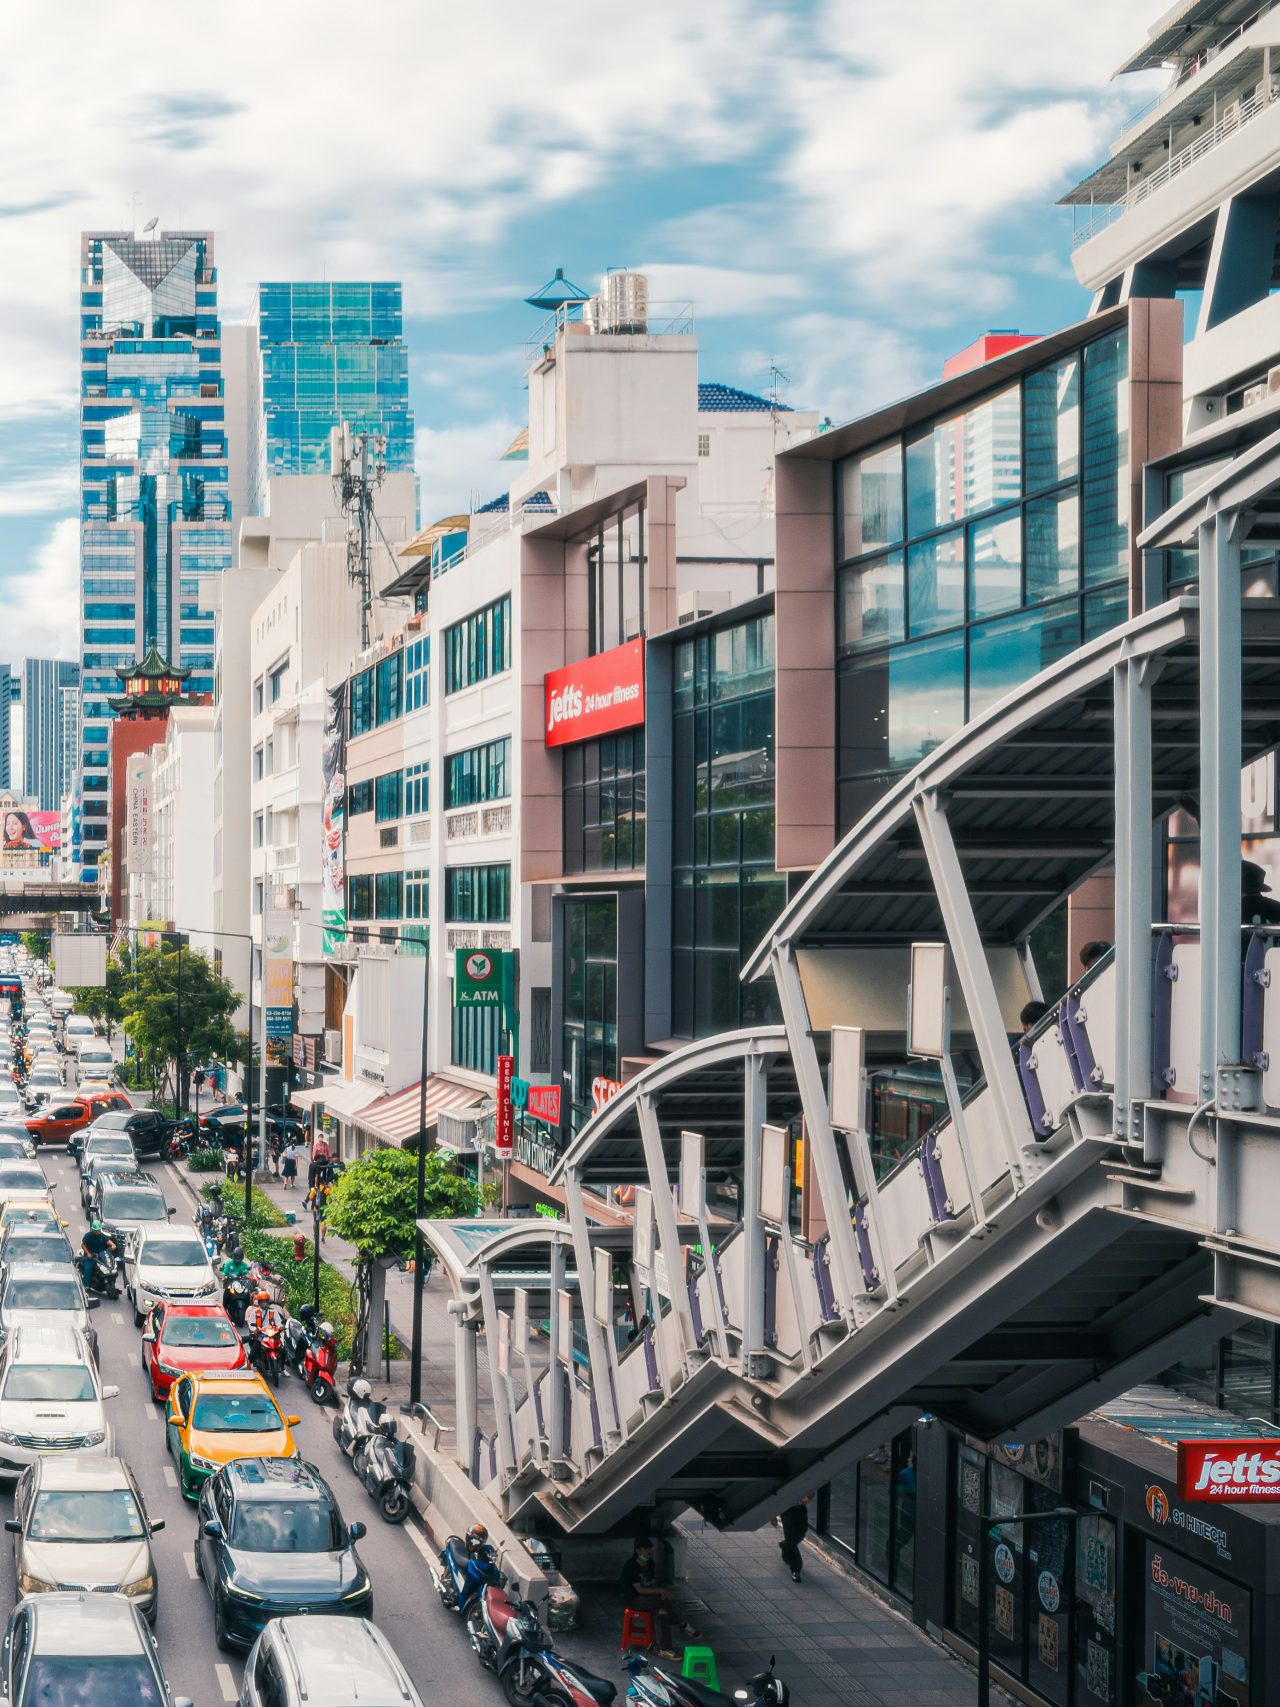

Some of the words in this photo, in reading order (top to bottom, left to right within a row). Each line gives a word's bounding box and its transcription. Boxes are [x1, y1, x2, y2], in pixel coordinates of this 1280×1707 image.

[548, 684, 582, 731] jetts
[585, 694, 595, 713] 24
[596, 692, 613, 710] hour
[614, 683, 639, 704] fitness
[473, 991, 499, 1001] ATM
[529, 1089, 558, 1118] PILATES
[1195, 1452, 1280, 1490] jetts
[1210, 1485, 1223, 1495] 24
[1224, 1484, 1248, 1494] hour
[1249, 1484, 1280, 1494] fitness
[1172, 1508, 1185, 1528] 91
[1186, 1514, 1227, 1548] HITECH
